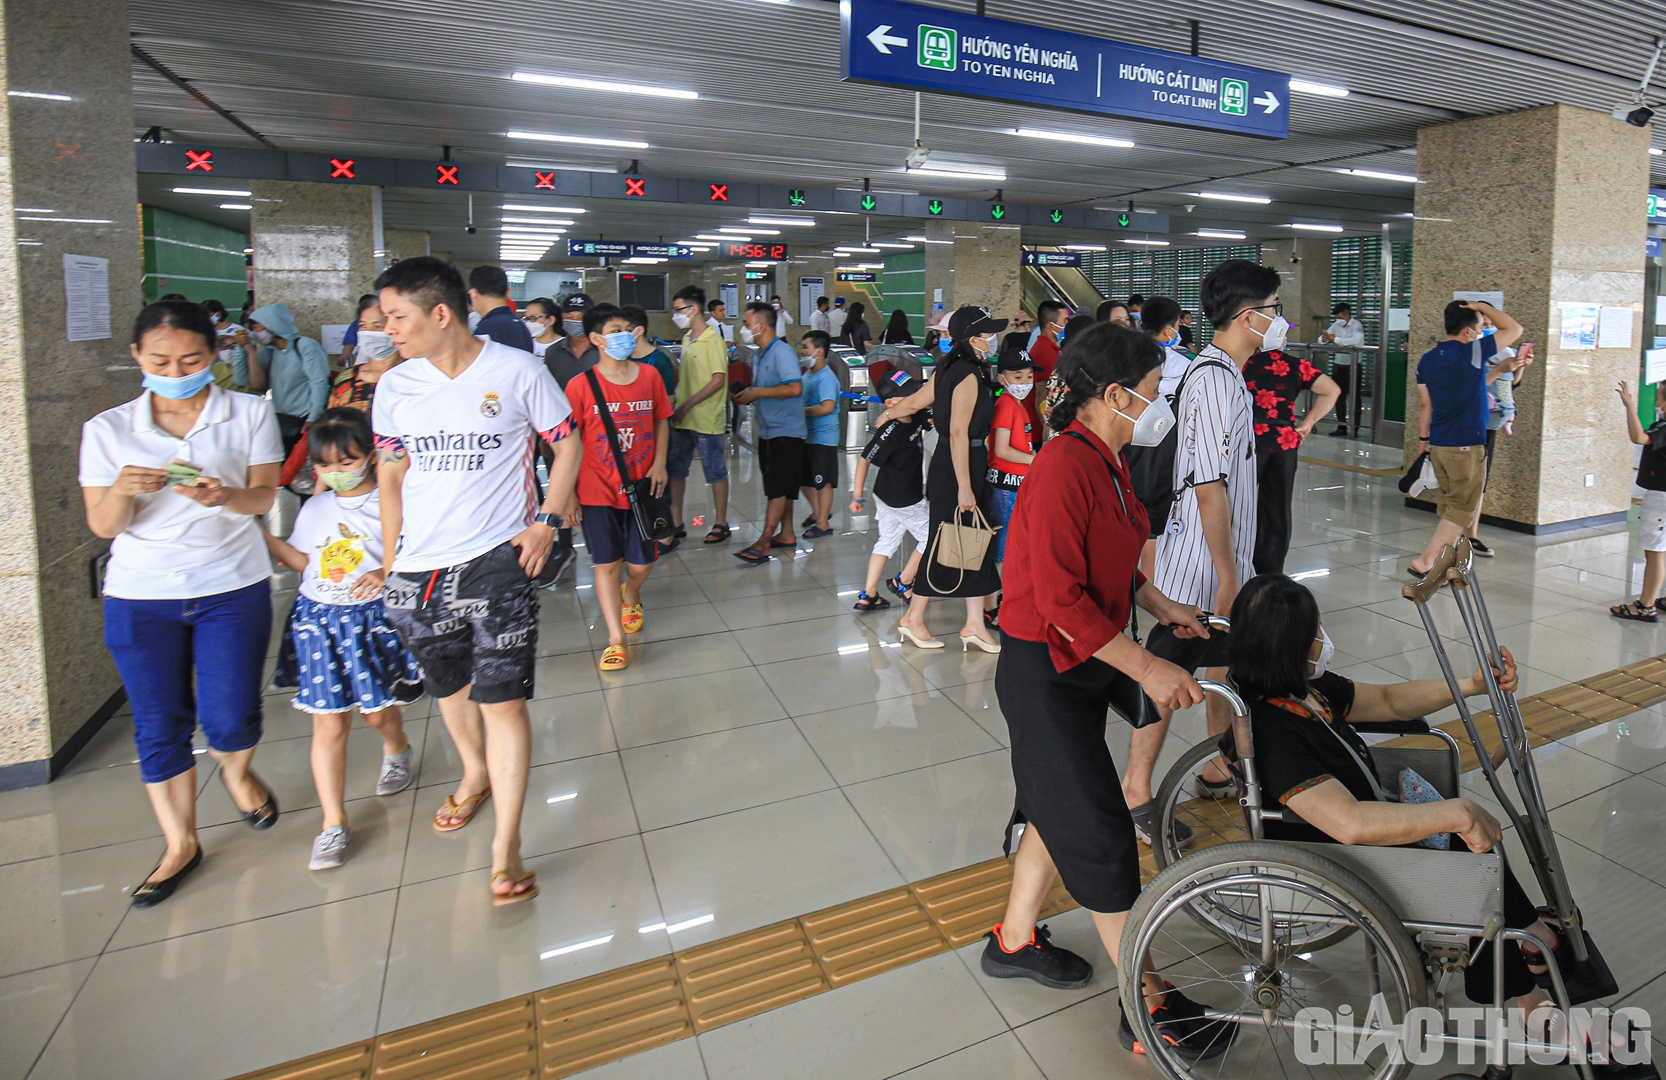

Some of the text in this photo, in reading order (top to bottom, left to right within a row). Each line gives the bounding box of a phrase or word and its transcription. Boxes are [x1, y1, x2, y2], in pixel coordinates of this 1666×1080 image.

[962, 36, 1079, 71] HƯỚNG YÊN NGHĨA
[962, 60, 1055, 85] TO YEN NGHIA
[1119, 63, 1217, 94] HƯỚNG CÁT LINH
[1152, 90, 1216, 110] TO CAT LINH
[418, 455, 434, 472] FLY
